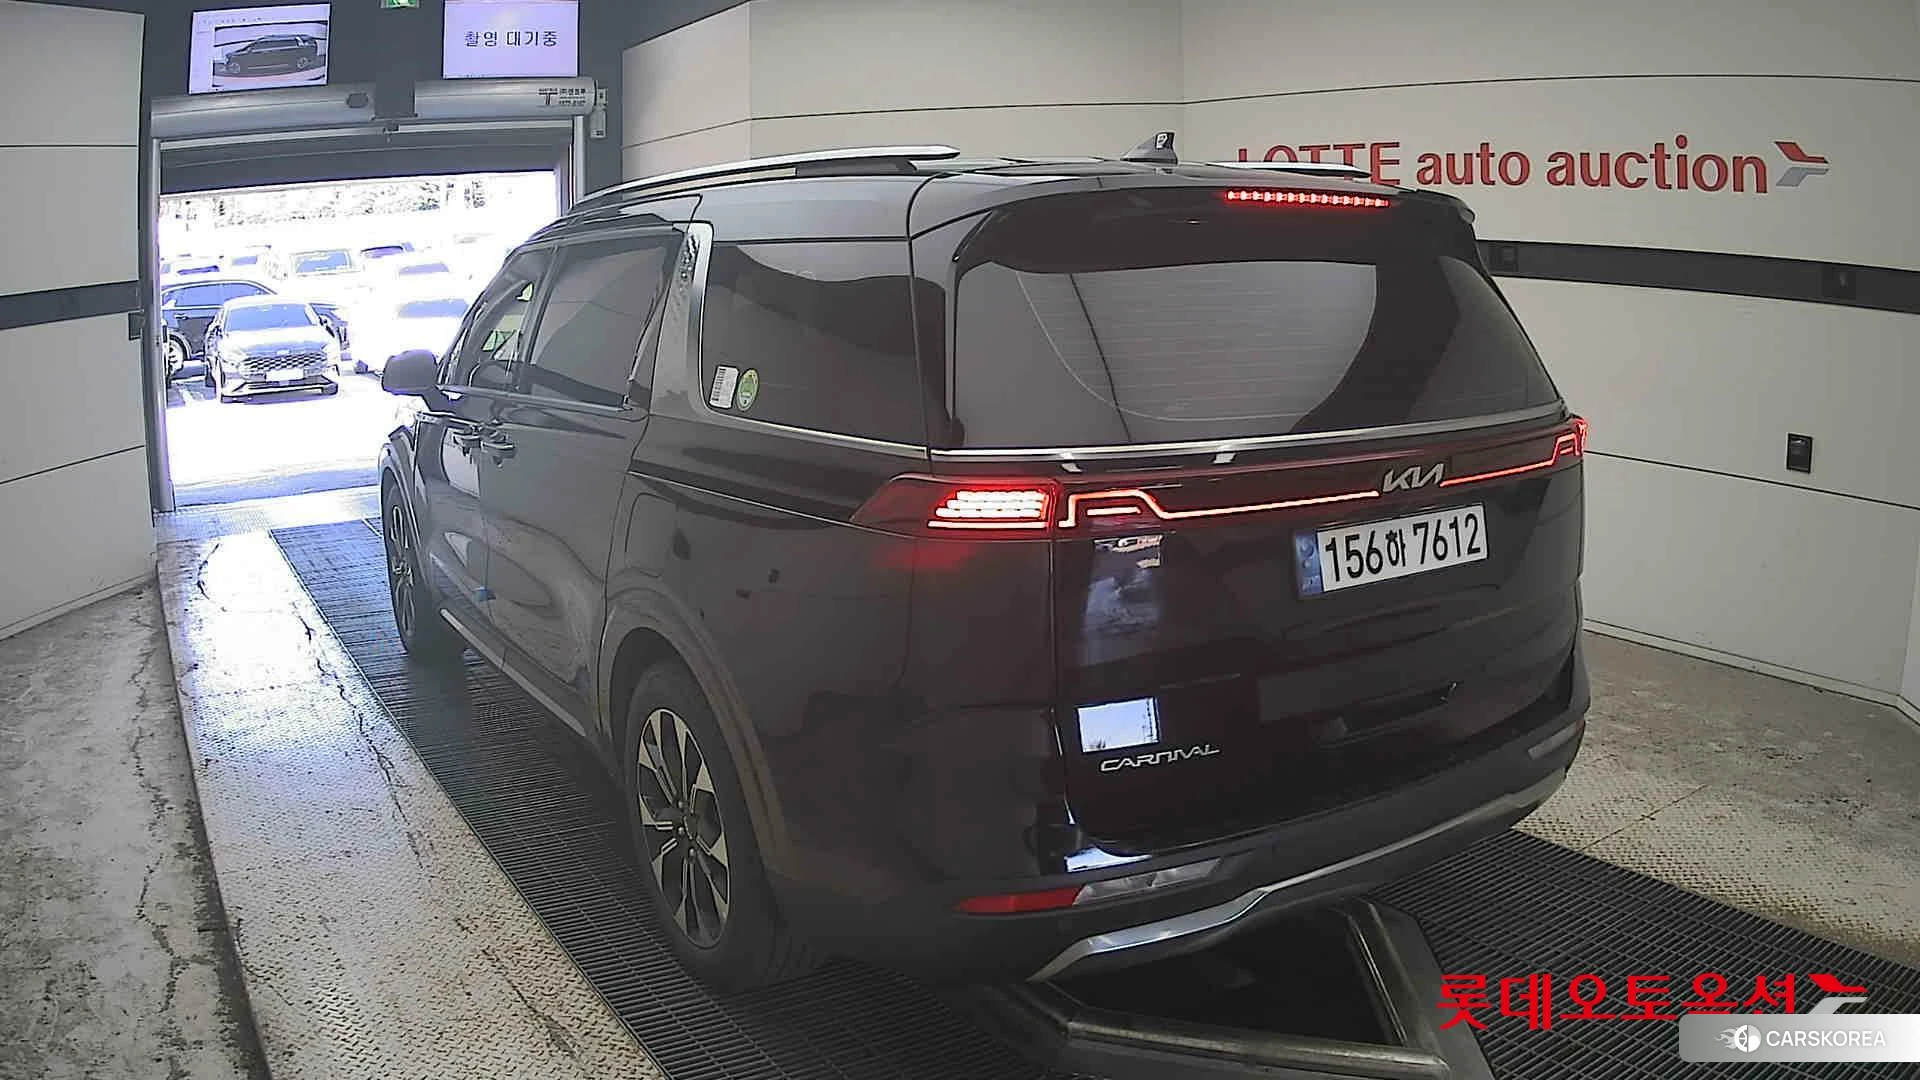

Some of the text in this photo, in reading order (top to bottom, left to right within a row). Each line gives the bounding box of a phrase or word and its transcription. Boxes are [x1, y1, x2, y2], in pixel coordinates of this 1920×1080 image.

[506, 31, 558, 47] 대기중
[1416, 142, 1531, 186] auto
[1546, 134, 1767, 193] auction
[1412, 512, 1481, 565] 7612
[1100, 744, 1220, 771] CARNIVAL
